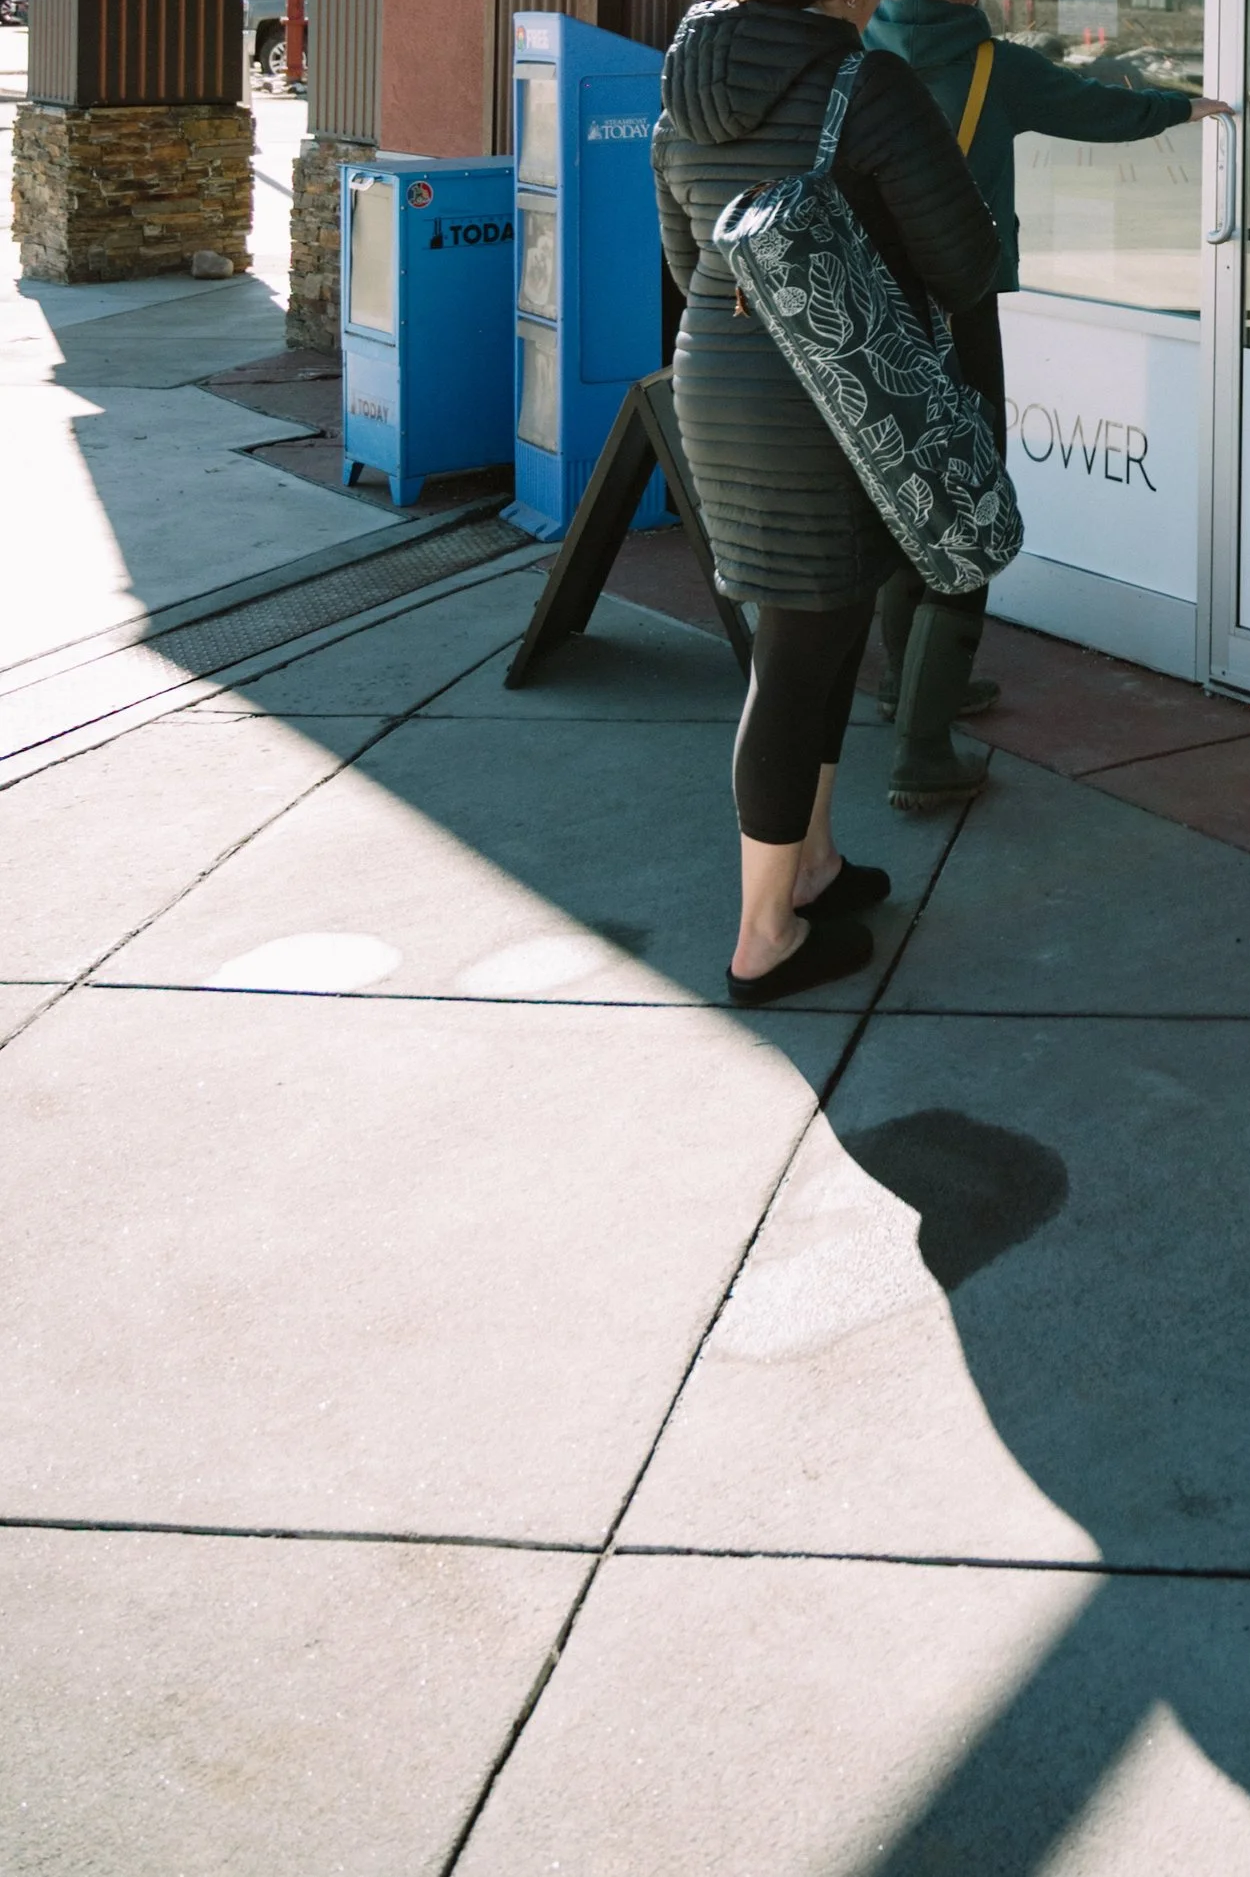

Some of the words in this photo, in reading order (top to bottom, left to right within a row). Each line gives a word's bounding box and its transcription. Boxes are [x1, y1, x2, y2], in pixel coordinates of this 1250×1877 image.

[601, 124, 651, 140] TODAY
[449, 221, 515, 245] TODA
[358, 398, 389, 424] TODAY
